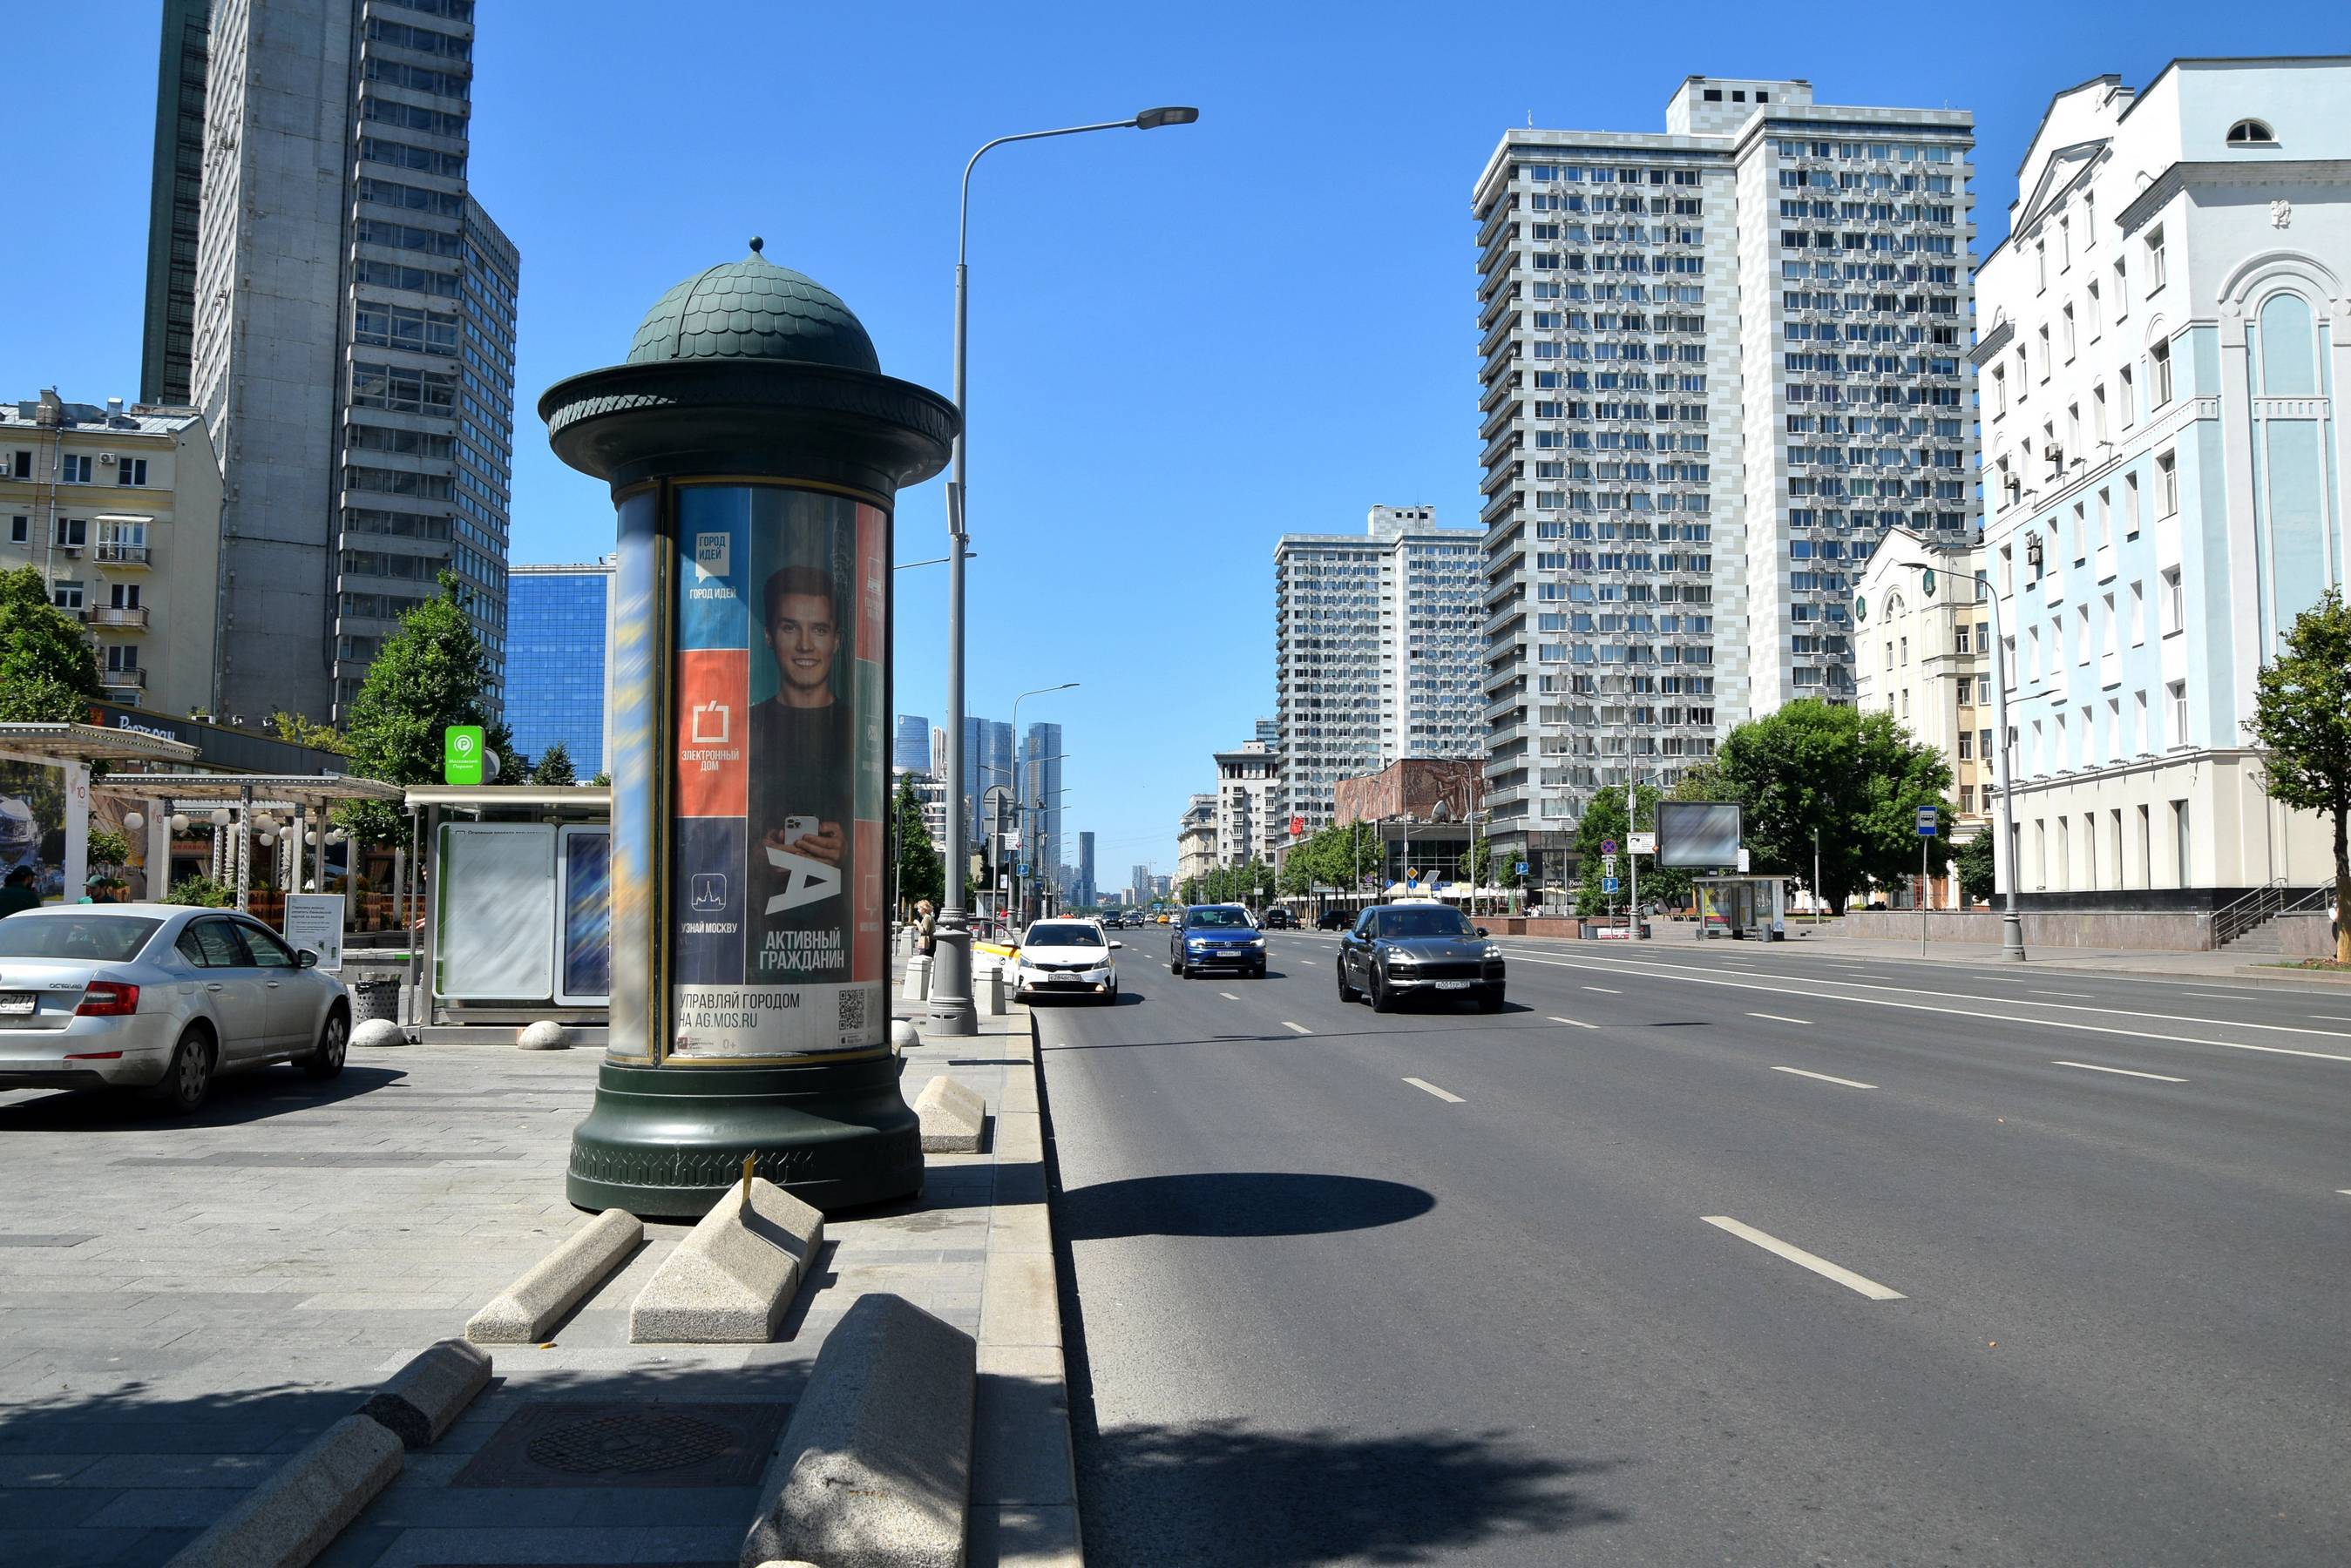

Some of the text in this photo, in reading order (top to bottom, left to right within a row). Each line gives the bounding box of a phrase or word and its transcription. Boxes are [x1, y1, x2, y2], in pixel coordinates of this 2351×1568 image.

[699, 536, 726, 547] ГОРОД
[699, 547, 722, 560] ИДЕЙ
[689, 586, 736, 599] ГОРОД ИДЕЙ
[701, 760, 719, 772] ДОМ
[681, 921, 737, 934] УЗНАЙ МОСКВУ
[765, 927, 841, 950] АКТИВНЫЙ
[759, 950, 844, 971] ГРАЖДАНИН
[680, 991, 800, 1010] УПРАВЛЯЙ ГОРОДОМ
[678, 1013, 757, 1028] НА AG.MOS.RU
[723, 1038, 736, 1050] 0+
